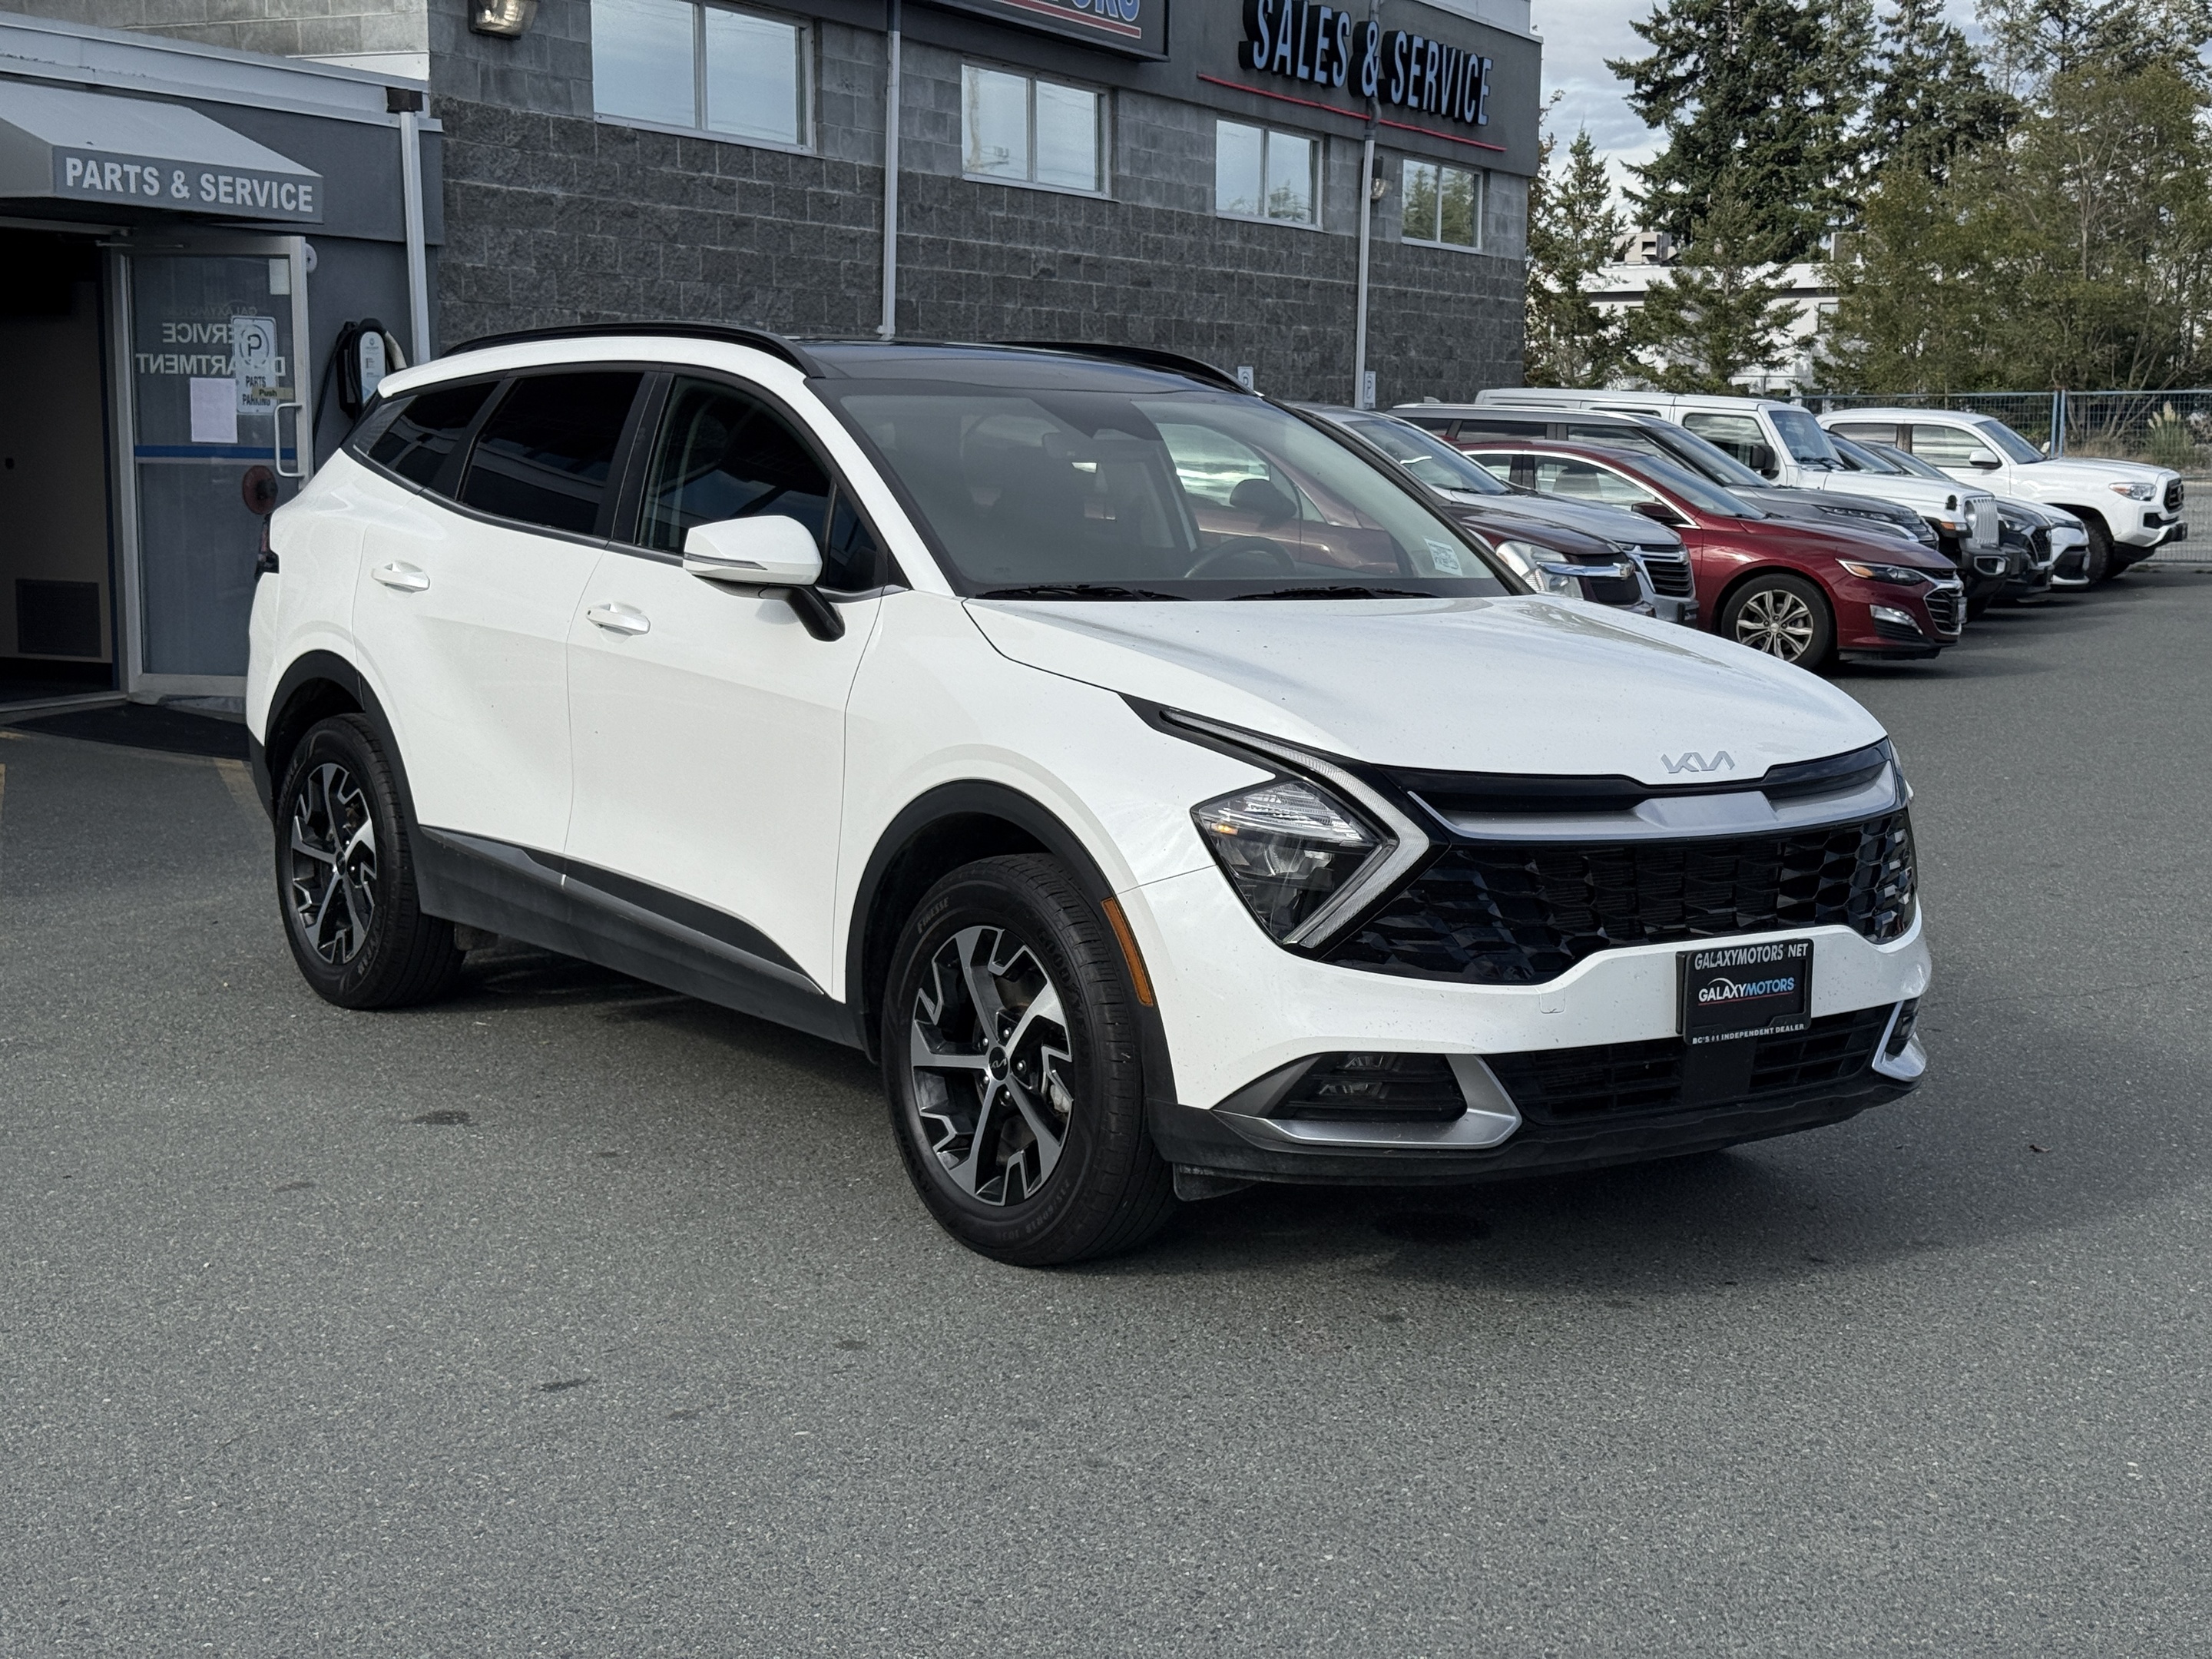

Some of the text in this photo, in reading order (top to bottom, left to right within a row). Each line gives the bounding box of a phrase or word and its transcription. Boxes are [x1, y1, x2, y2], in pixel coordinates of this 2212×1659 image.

[1252, 0, 1495, 126] SALES & SERVICE
[65, 157, 314, 213] PARTS & SERVICE
[245, 375, 267, 388] PARTS
[258, 389, 278, 397] Push
[1660, 750, 1736, 774] KIA
[1694, 944, 1783, 970] GALAXYMOTORS
[1698, 977, 1795, 1002] GALAXYMOTORS
[1692, 1035, 1710, 1045] BC'S
[1720, 1027, 1774, 1040] INDEPENDENT
[1775, 1023, 1805, 1034] DEALER
